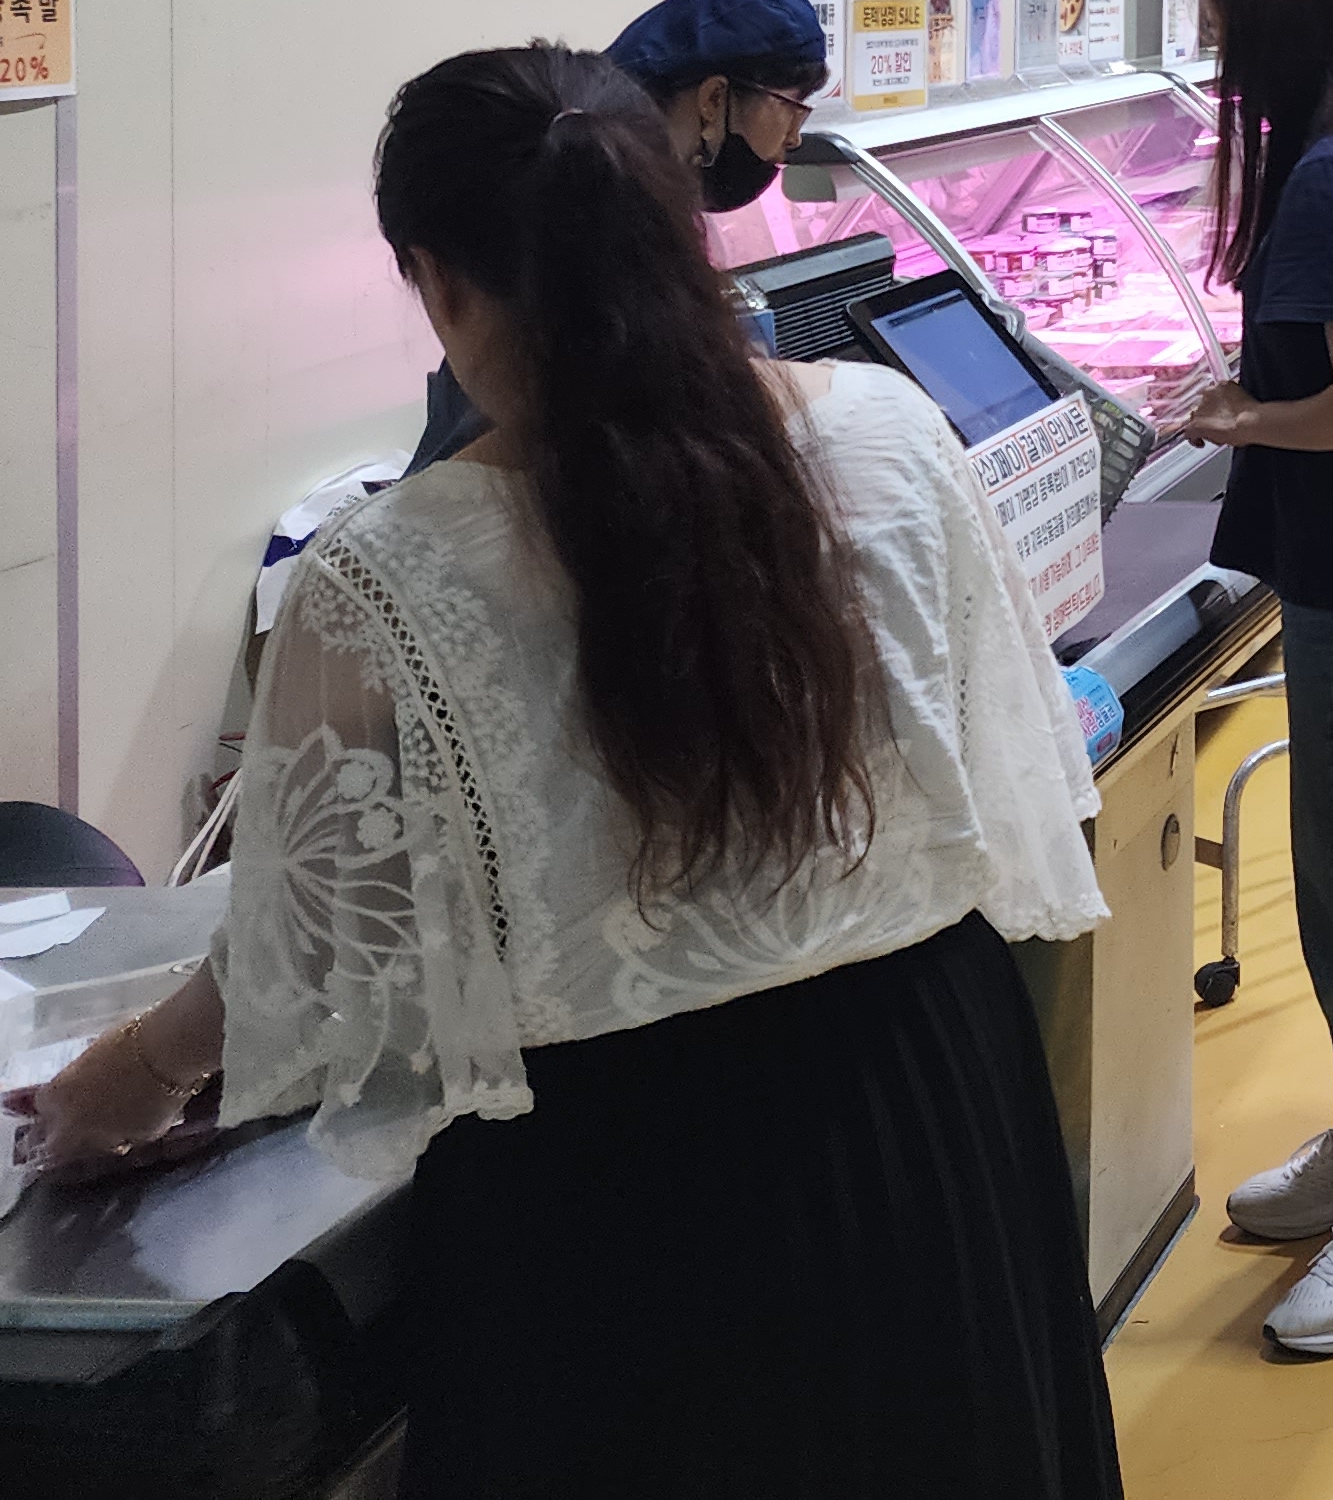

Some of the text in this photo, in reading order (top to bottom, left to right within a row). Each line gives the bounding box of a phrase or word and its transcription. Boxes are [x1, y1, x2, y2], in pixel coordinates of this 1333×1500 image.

[899, 6, 920, 25] SALE
[871, 51, 911, 75] 20% 할인
[1019, 425, 1054, 463] 결제
[1047, 406, 1089, 448] 안내문
